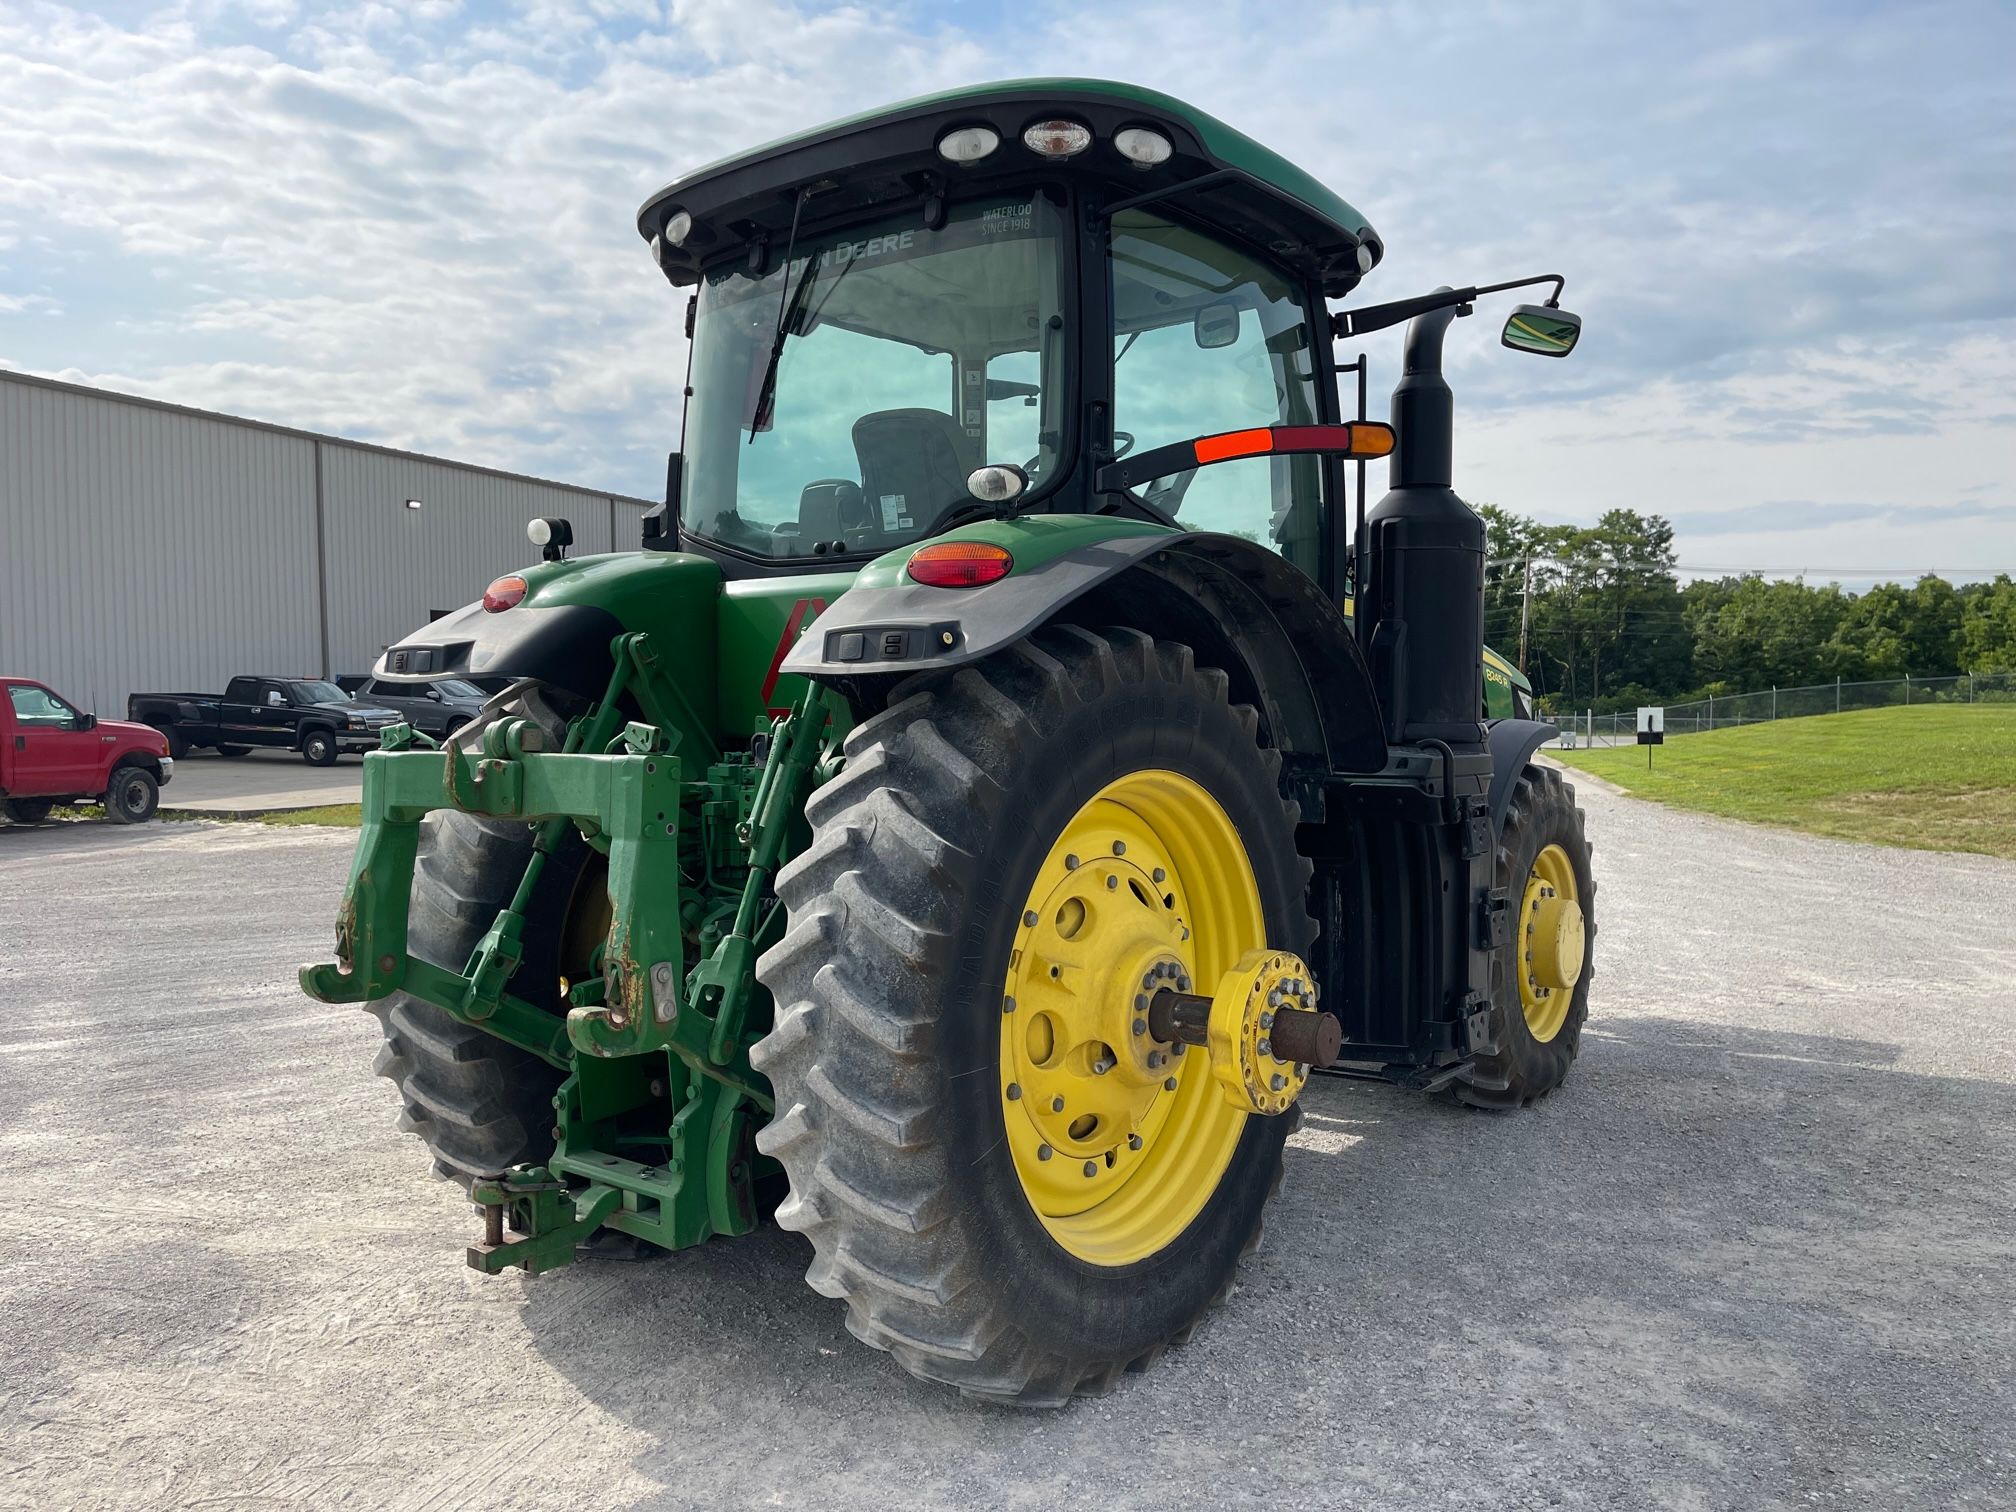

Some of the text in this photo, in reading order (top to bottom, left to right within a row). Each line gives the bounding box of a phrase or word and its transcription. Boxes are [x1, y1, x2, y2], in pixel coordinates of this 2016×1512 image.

[983, 204, 1032, 221] WATERLOO
[982, 217, 1031, 234] SINCE 1918
[836, 229, 915, 264] DEERE
